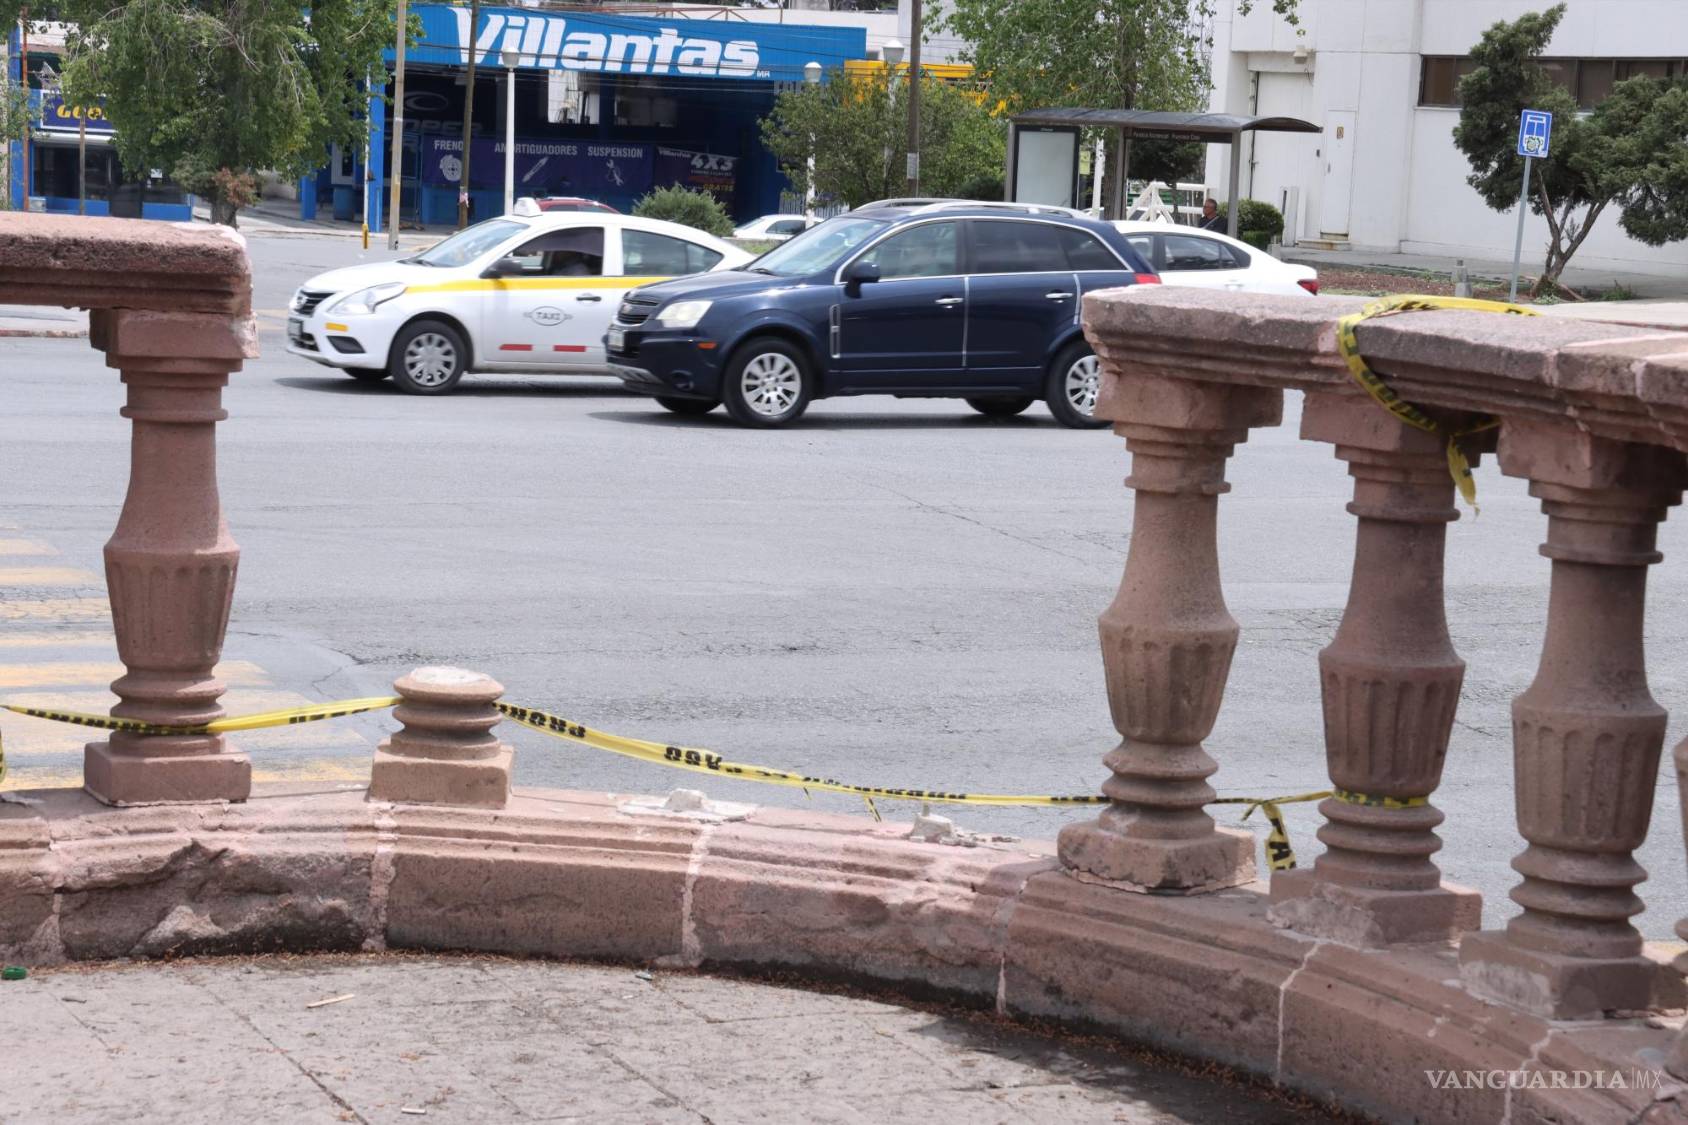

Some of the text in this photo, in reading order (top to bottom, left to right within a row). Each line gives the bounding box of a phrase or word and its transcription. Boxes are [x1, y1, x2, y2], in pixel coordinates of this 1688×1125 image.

[450, 7, 760, 77] Villantas
[494, 142, 578, 156] AMRTIGUADORES
[587, 145, 643, 159] SUSPENSION
[536, 311, 561, 320] TAXI
